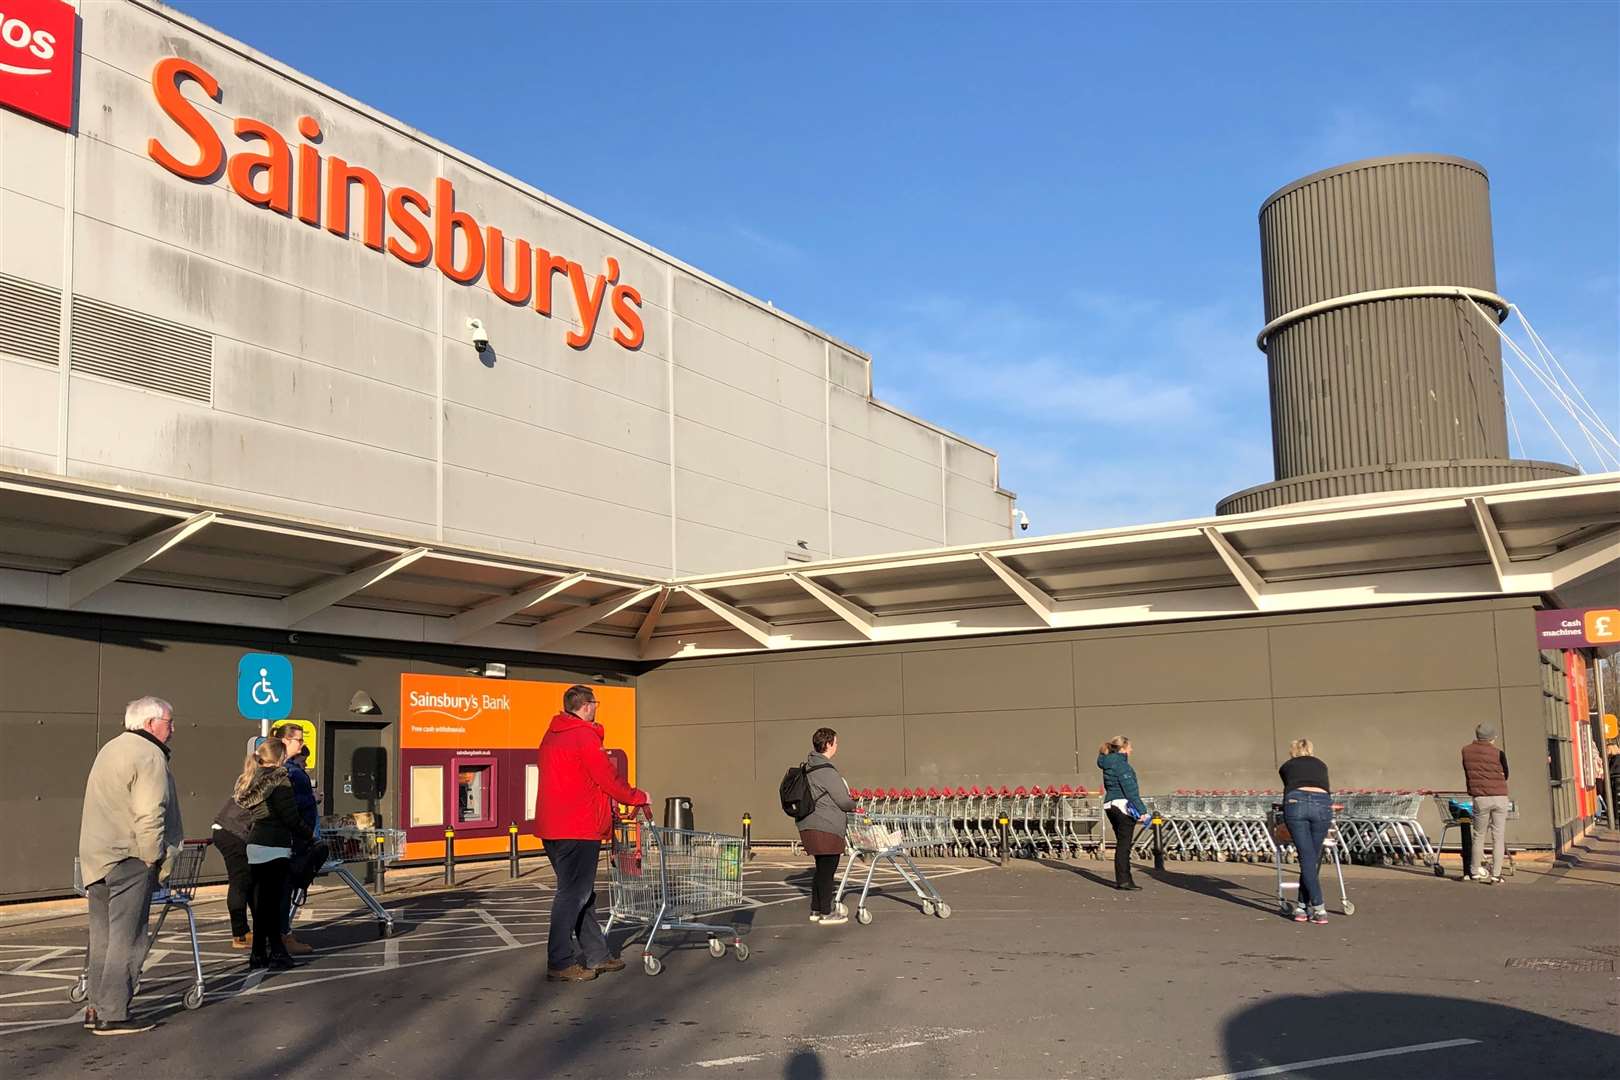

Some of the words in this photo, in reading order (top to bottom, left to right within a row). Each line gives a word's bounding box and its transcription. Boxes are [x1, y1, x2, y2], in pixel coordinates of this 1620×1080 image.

[0, 12, 56, 59] os
[148, 57, 645, 350] Sainsbury's
[1542, 629, 1582, 637] machines
[410, 691, 479, 711] Sainsbury's
[482, 695, 510, 710] Bank
